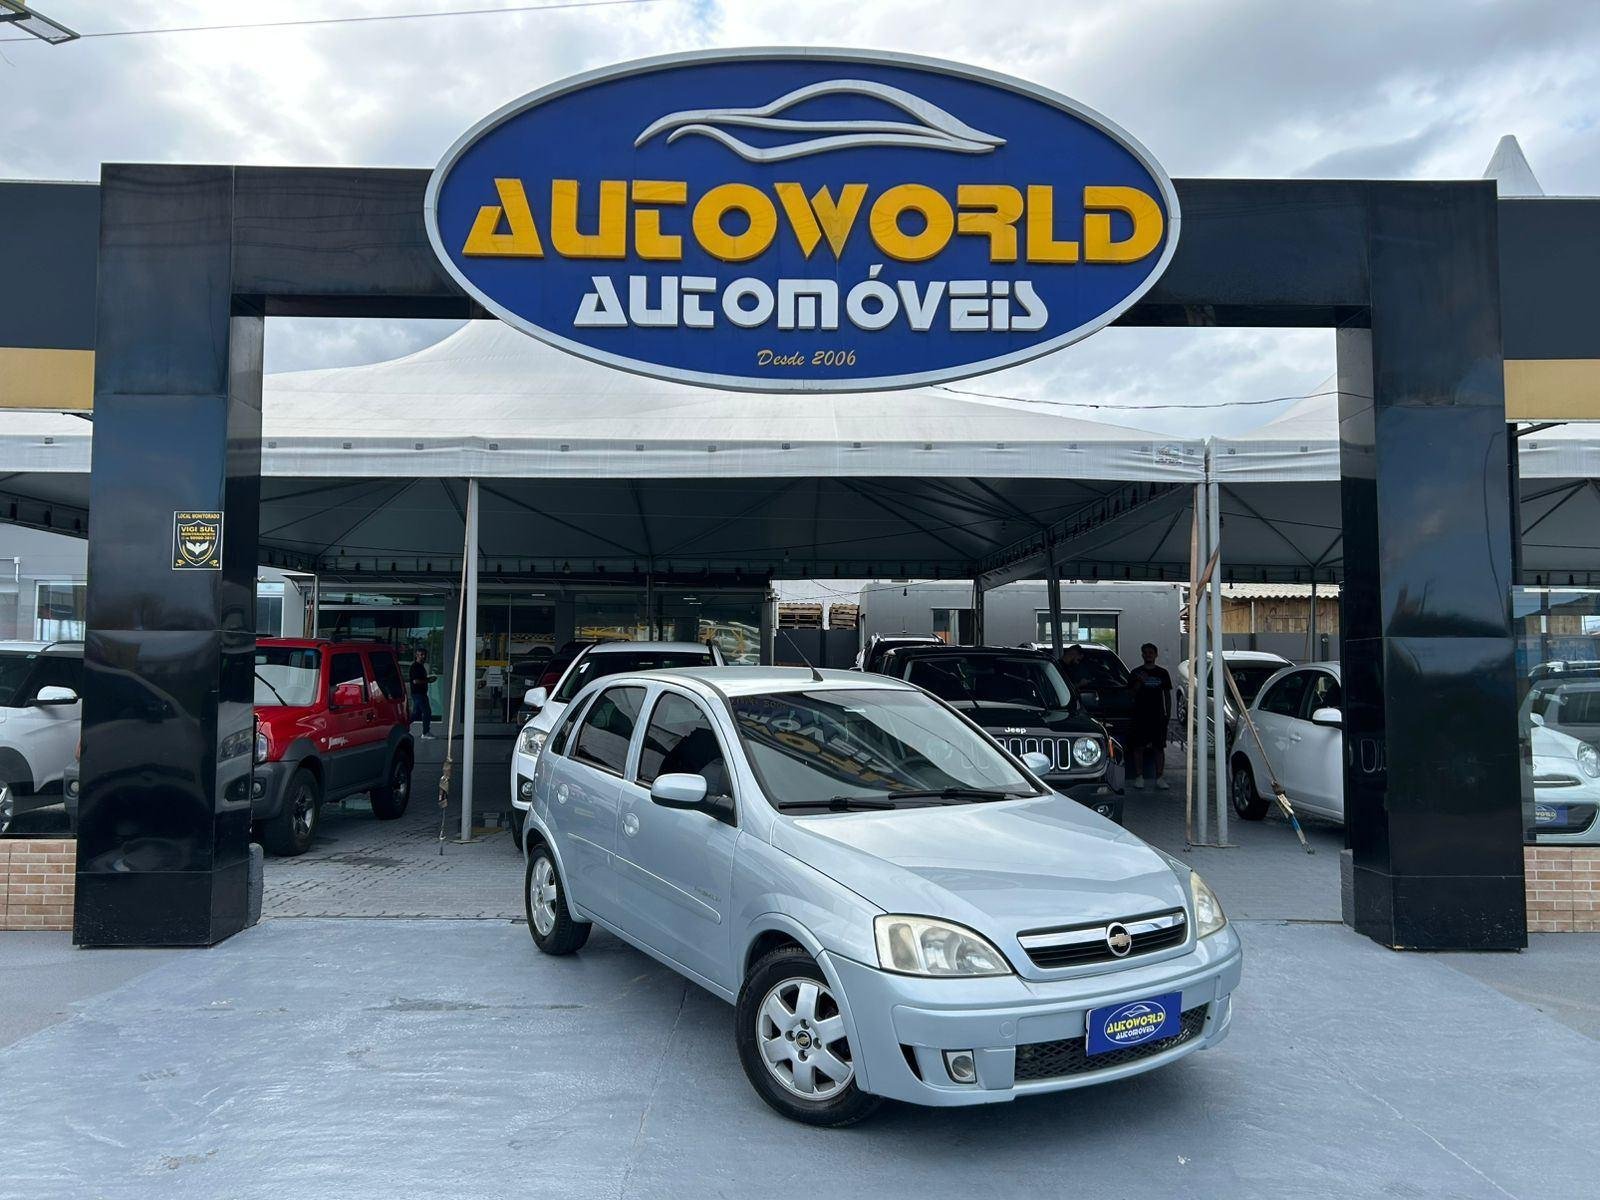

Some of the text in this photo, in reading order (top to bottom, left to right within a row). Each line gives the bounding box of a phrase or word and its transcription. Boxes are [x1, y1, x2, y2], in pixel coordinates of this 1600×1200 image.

[462, 177, 1165, 264] AUTOWORLD
[757, 349, 857, 366] Desde 2006
[1004, 726, 1027, 735] Jeep
[1107, 1012, 1164, 1034] AUTOWORLD
